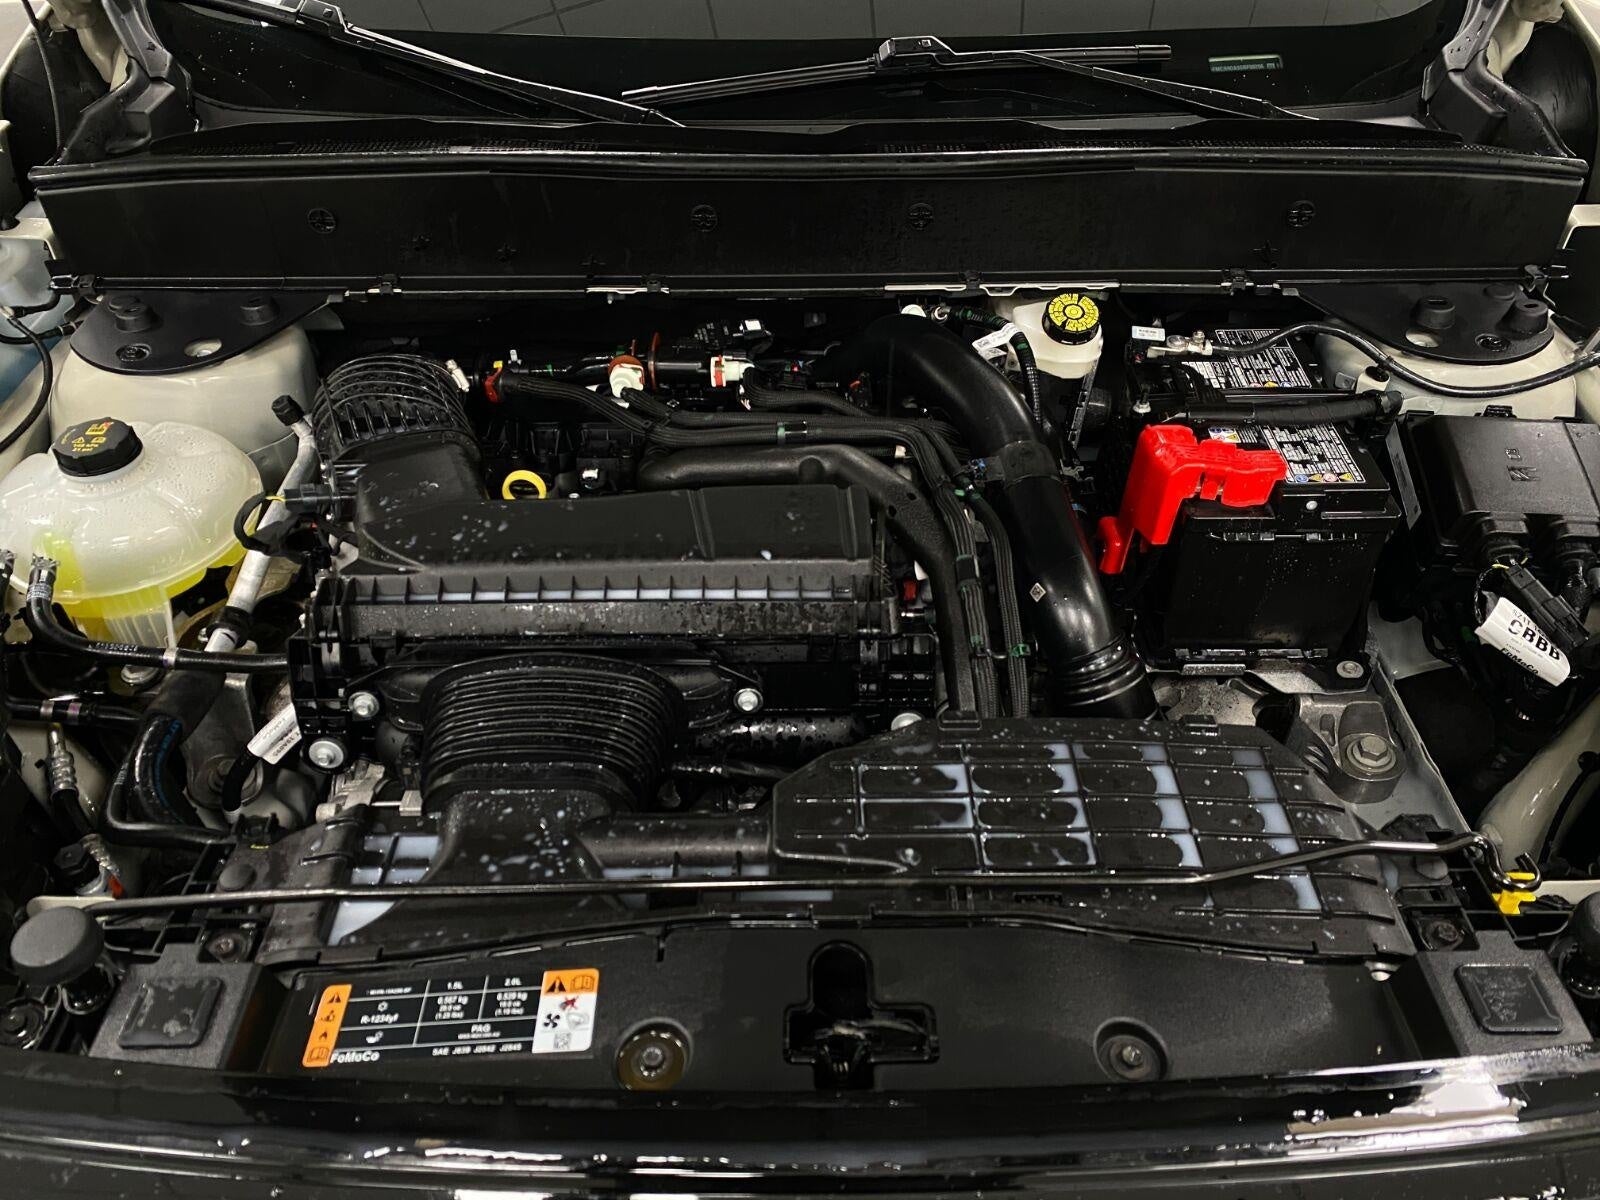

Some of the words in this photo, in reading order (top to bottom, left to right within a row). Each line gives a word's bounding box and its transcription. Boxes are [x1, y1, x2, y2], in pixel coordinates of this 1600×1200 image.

[1508, 619, 1560, 661] CBBB
[471, 1023, 492, 1034] PAG
[330, 1050, 380, 1064] FoMoCo
